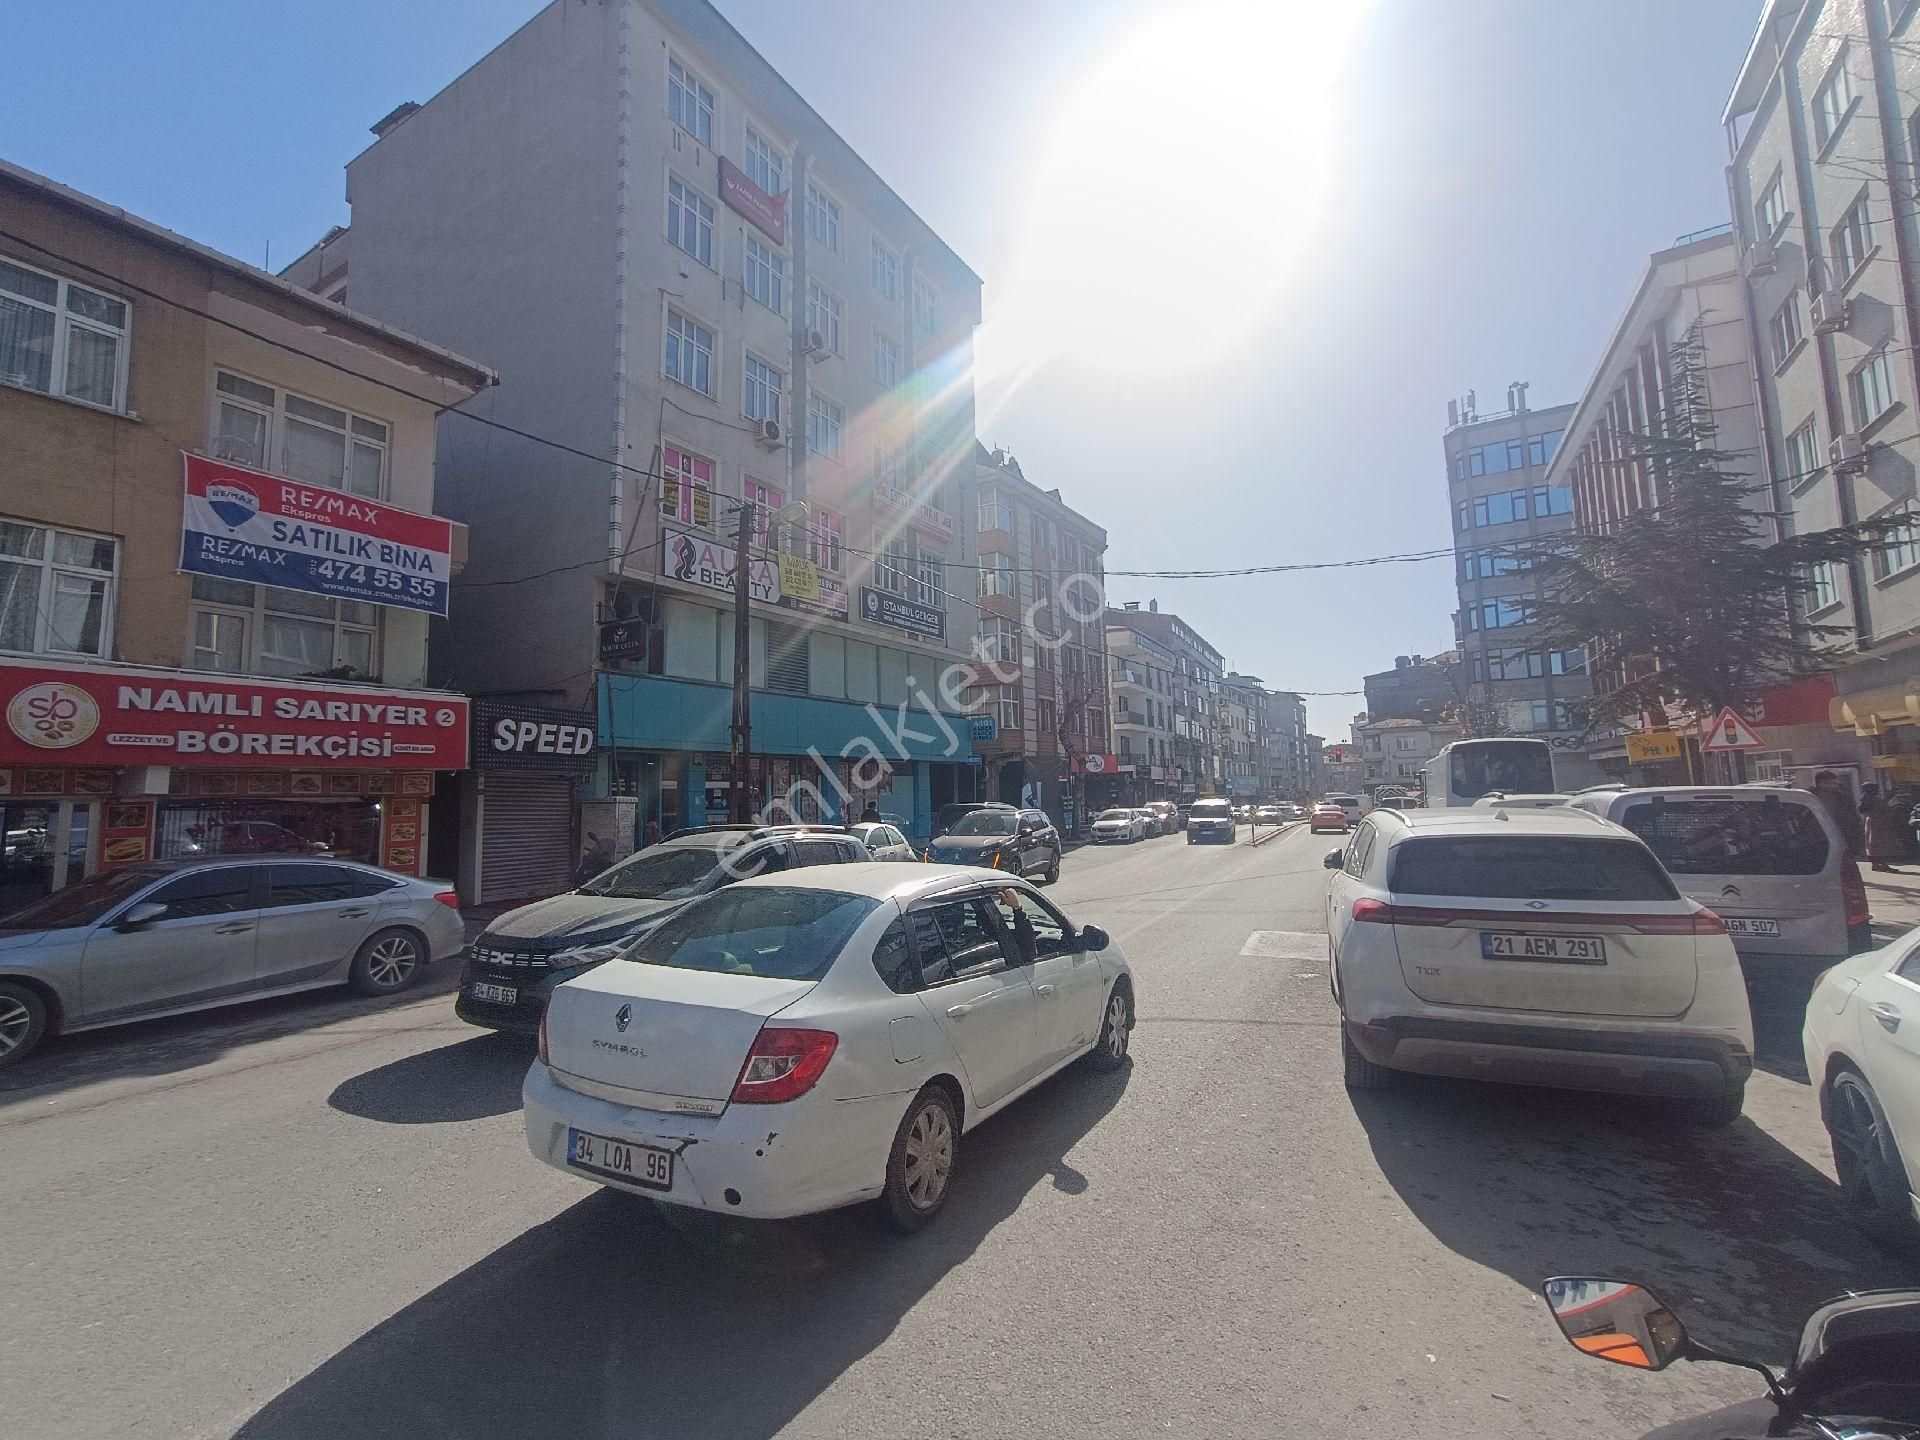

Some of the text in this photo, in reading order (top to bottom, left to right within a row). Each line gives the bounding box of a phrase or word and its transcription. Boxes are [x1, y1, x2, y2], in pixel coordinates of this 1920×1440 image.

[212, 489, 254, 506] RE/MAX
[281, 485, 378, 525] RE/MAX
[281, 505, 331, 523] Ekspres
[201, 535, 287, 566] RE/MAX
[272, 520, 372, 560] SATILIK
[201, 551, 245, 567] Ekspres
[318, 559, 366, 584] 474
[374, 568, 403, 590] 55
[409, 577, 436, 597] 55
[701, 568, 772, 600] BEATY
[117, 685, 263, 717] NAMLI
[275, 697, 428, 726] SARIYER
[112, 735, 153, 744] LEZZET
[176, 723, 392, 760] BÖREKÇİSİ
[494, 718, 594, 755] SPEED
[1751, 920, 1775, 932] 507
[1493, 936, 1599, 958] 21 AEM 291
[592, 1039, 648, 1058] SYMBOL
[577, 1135, 667, 1180] 34 LOA 96
